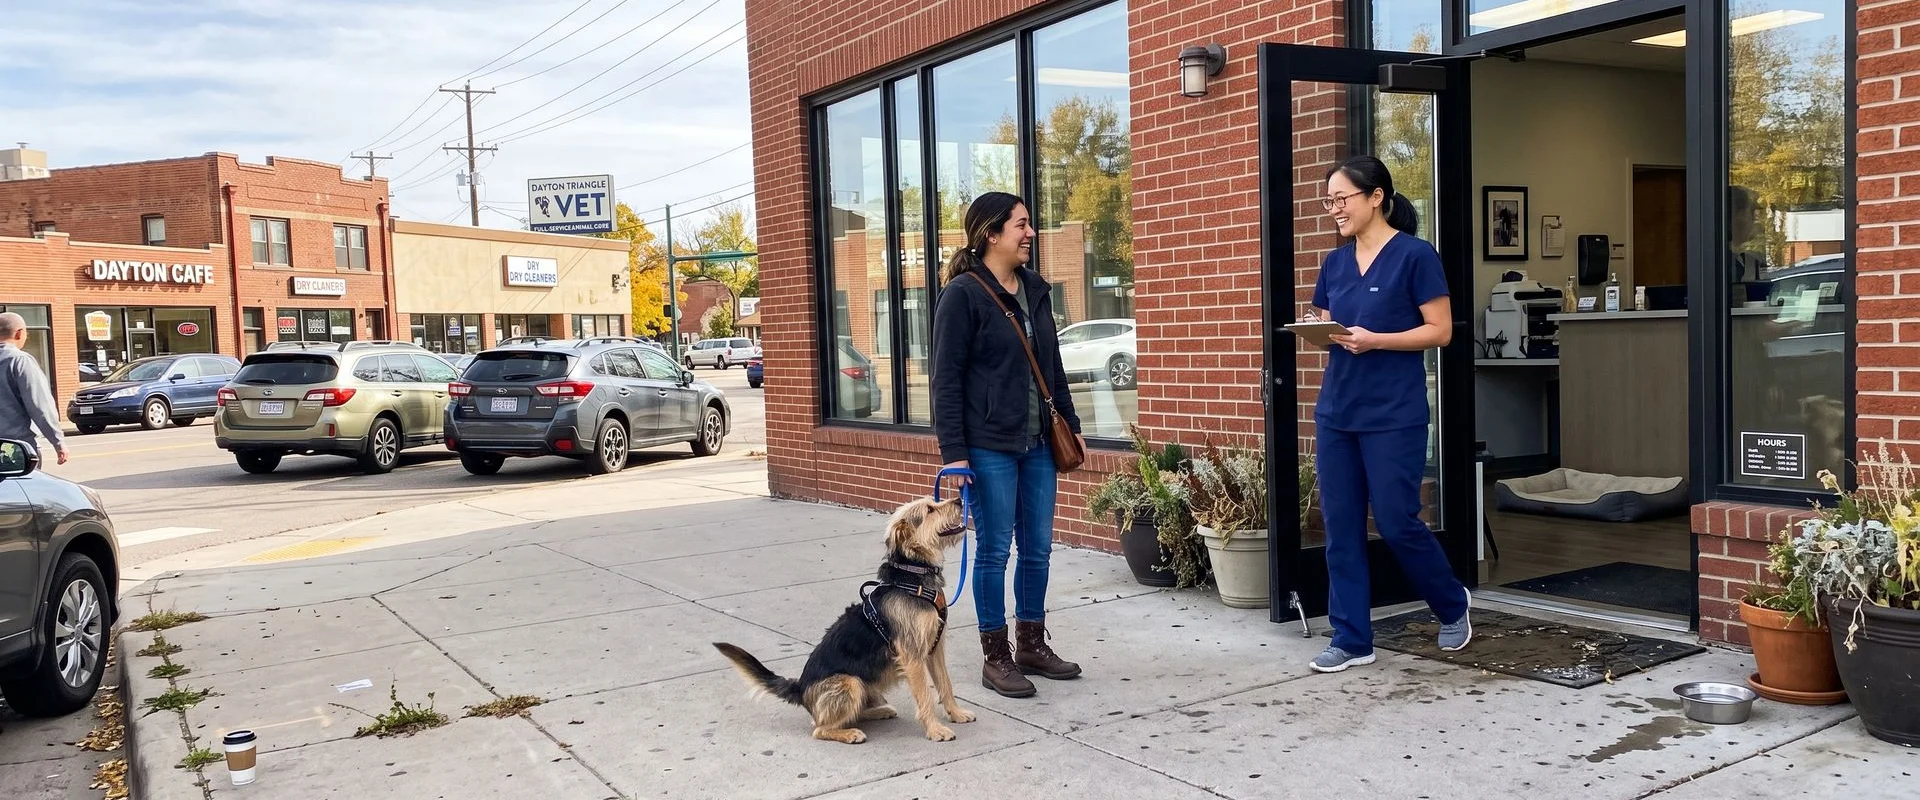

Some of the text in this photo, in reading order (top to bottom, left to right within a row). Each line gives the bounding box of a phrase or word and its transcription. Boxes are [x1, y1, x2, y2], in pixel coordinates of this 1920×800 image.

[532, 180, 606, 192] DAYTON TRIANGLE
[554, 192, 606, 218] VET
[527, 261, 540, 271] DRY
[93, 260, 215, 285] DAYTON CAFE
[510, 271, 557, 283] DRY CLEANERS
[296, 280, 345, 292] DRY CLANERS
[1757, 438, 1787, 447] HOURS
